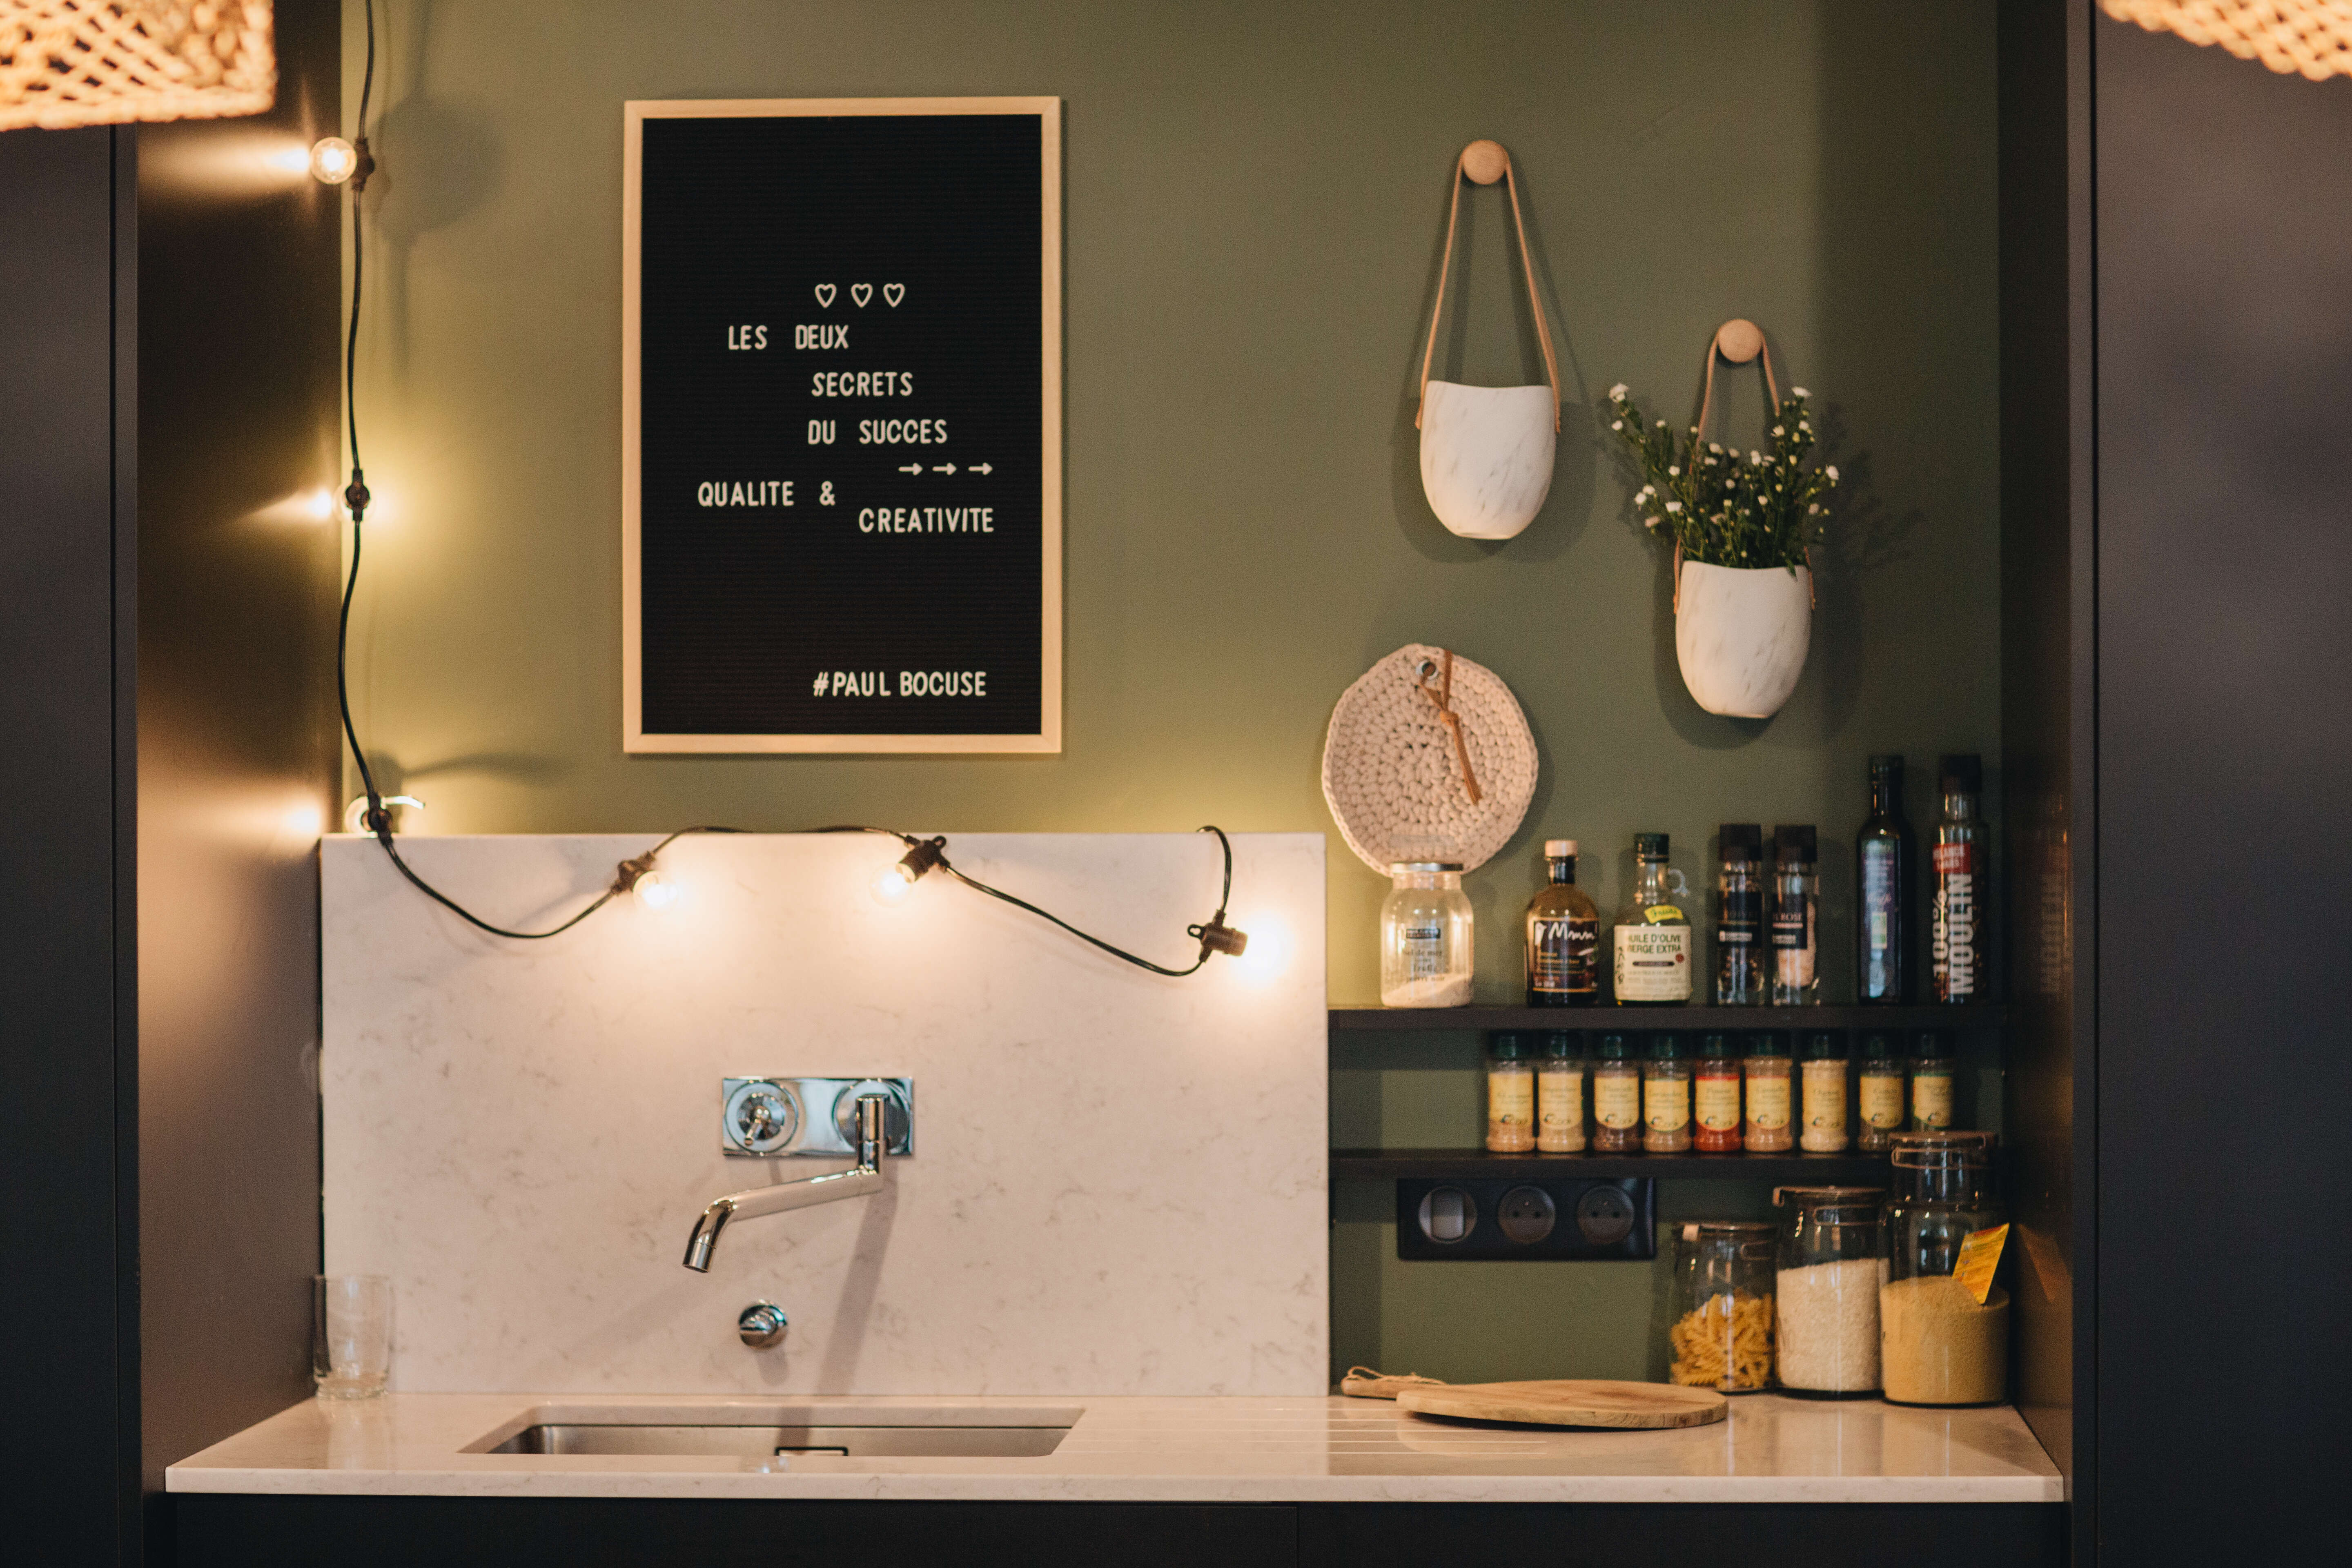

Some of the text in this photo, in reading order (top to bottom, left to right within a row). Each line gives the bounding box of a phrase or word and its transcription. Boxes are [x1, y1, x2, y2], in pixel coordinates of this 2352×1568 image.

[728, 325, 849, 350] LES DEUX
[811, 372, 913, 397] SECRETS
[808, 419, 947, 445] DU SUCCES
[697, 481, 835, 507] QUALITE &
[858, 508, 994, 533] CREATIVITE
[813, 671, 987, 697] #PAUL BOCUSE
[1948, 873, 1974, 994] MOULIN
